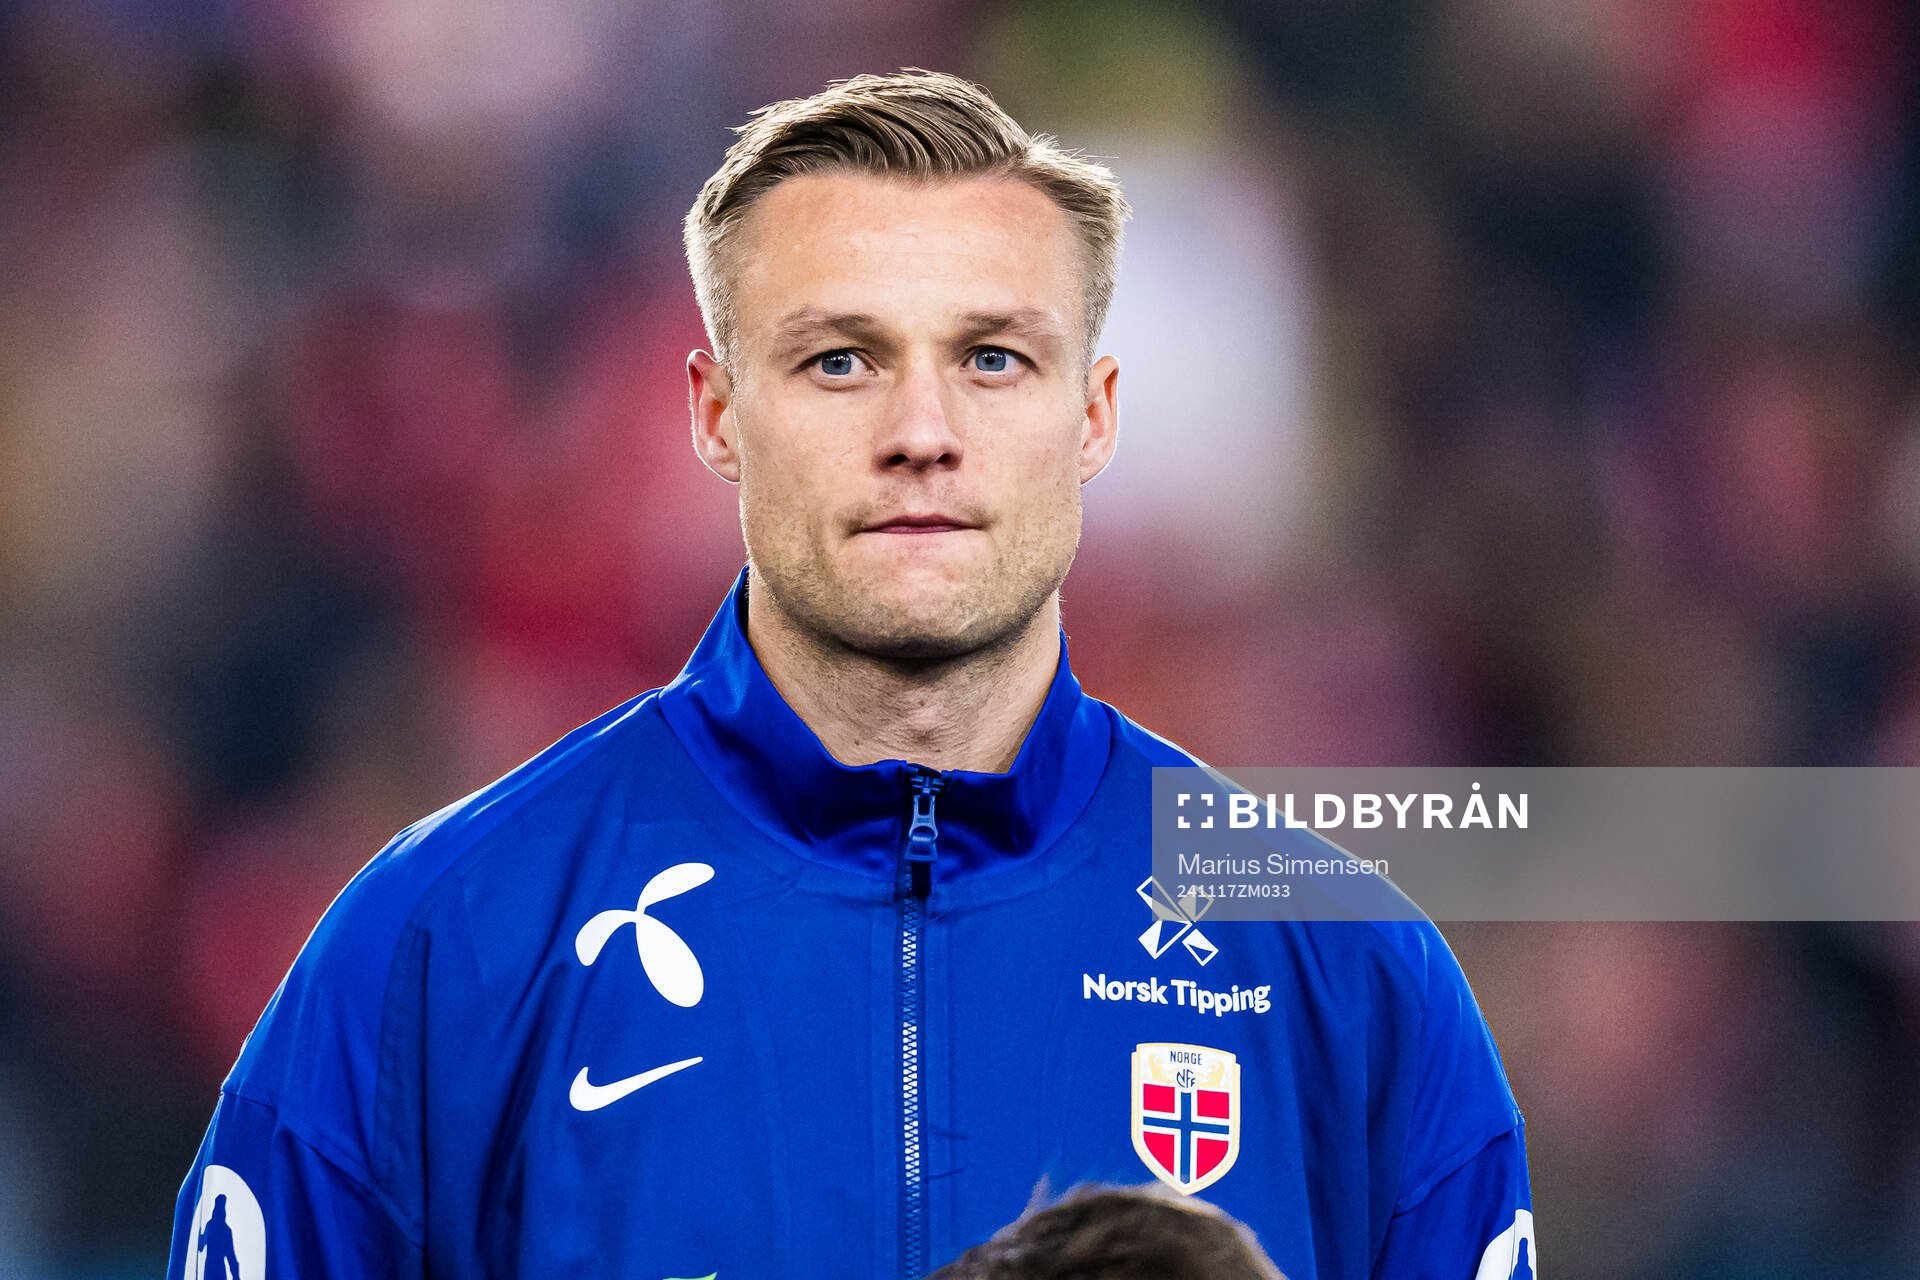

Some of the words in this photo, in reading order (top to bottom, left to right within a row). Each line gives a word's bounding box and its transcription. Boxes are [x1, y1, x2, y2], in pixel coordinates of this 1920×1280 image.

[1082, 973, 1169, 1005] Norsk
[1170, 979, 1272, 1017] Tipping
[1169, 1050, 1204, 1065] NORGE
